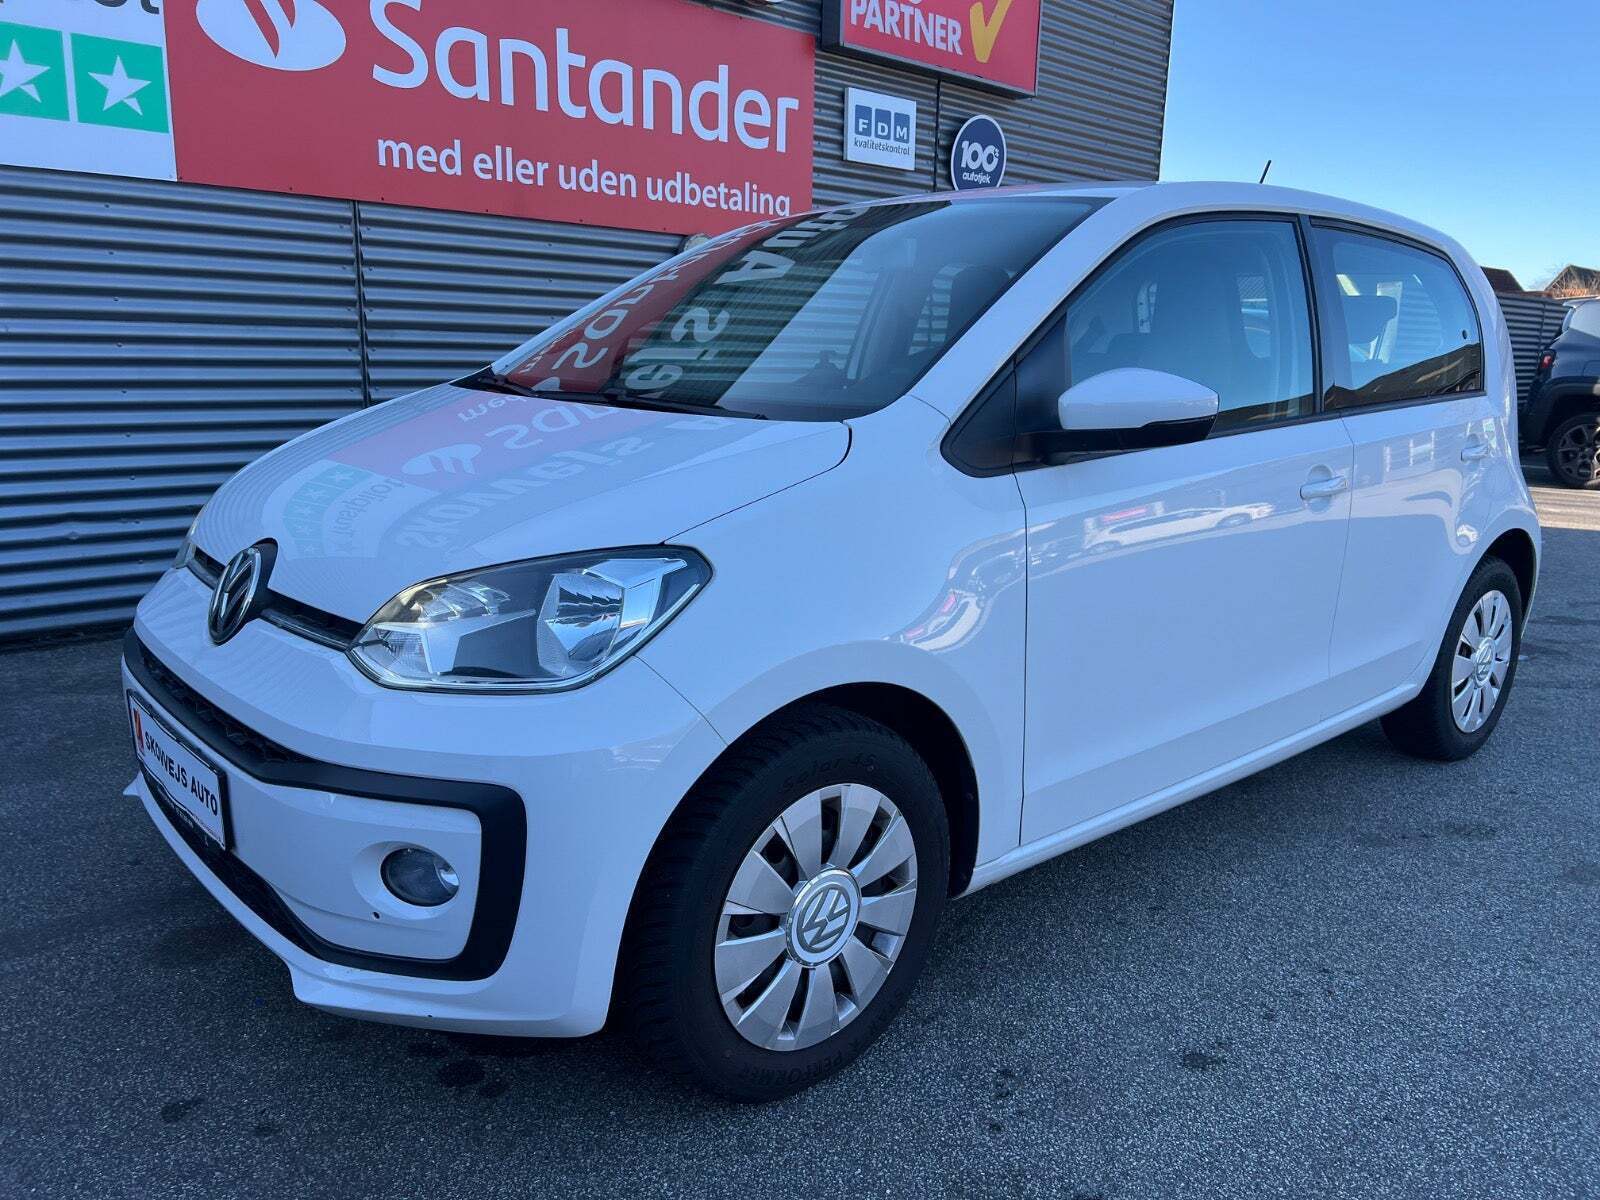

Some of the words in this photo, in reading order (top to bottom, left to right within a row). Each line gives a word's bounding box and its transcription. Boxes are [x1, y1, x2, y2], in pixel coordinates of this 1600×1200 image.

[850, 0, 963, 55] PARTNER
[369, 0, 799, 153] Santander
[854, 137, 910, 156] kvalitetskontrol
[858, 118, 908, 140] FDM
[377, 138, 462, 176] med
[473, 145, 549, 186] eller
[558, 159, 637, 198] uden
[646, 171, 791, 217] udbetaling
[191, 776, 218, 817] AUTO
